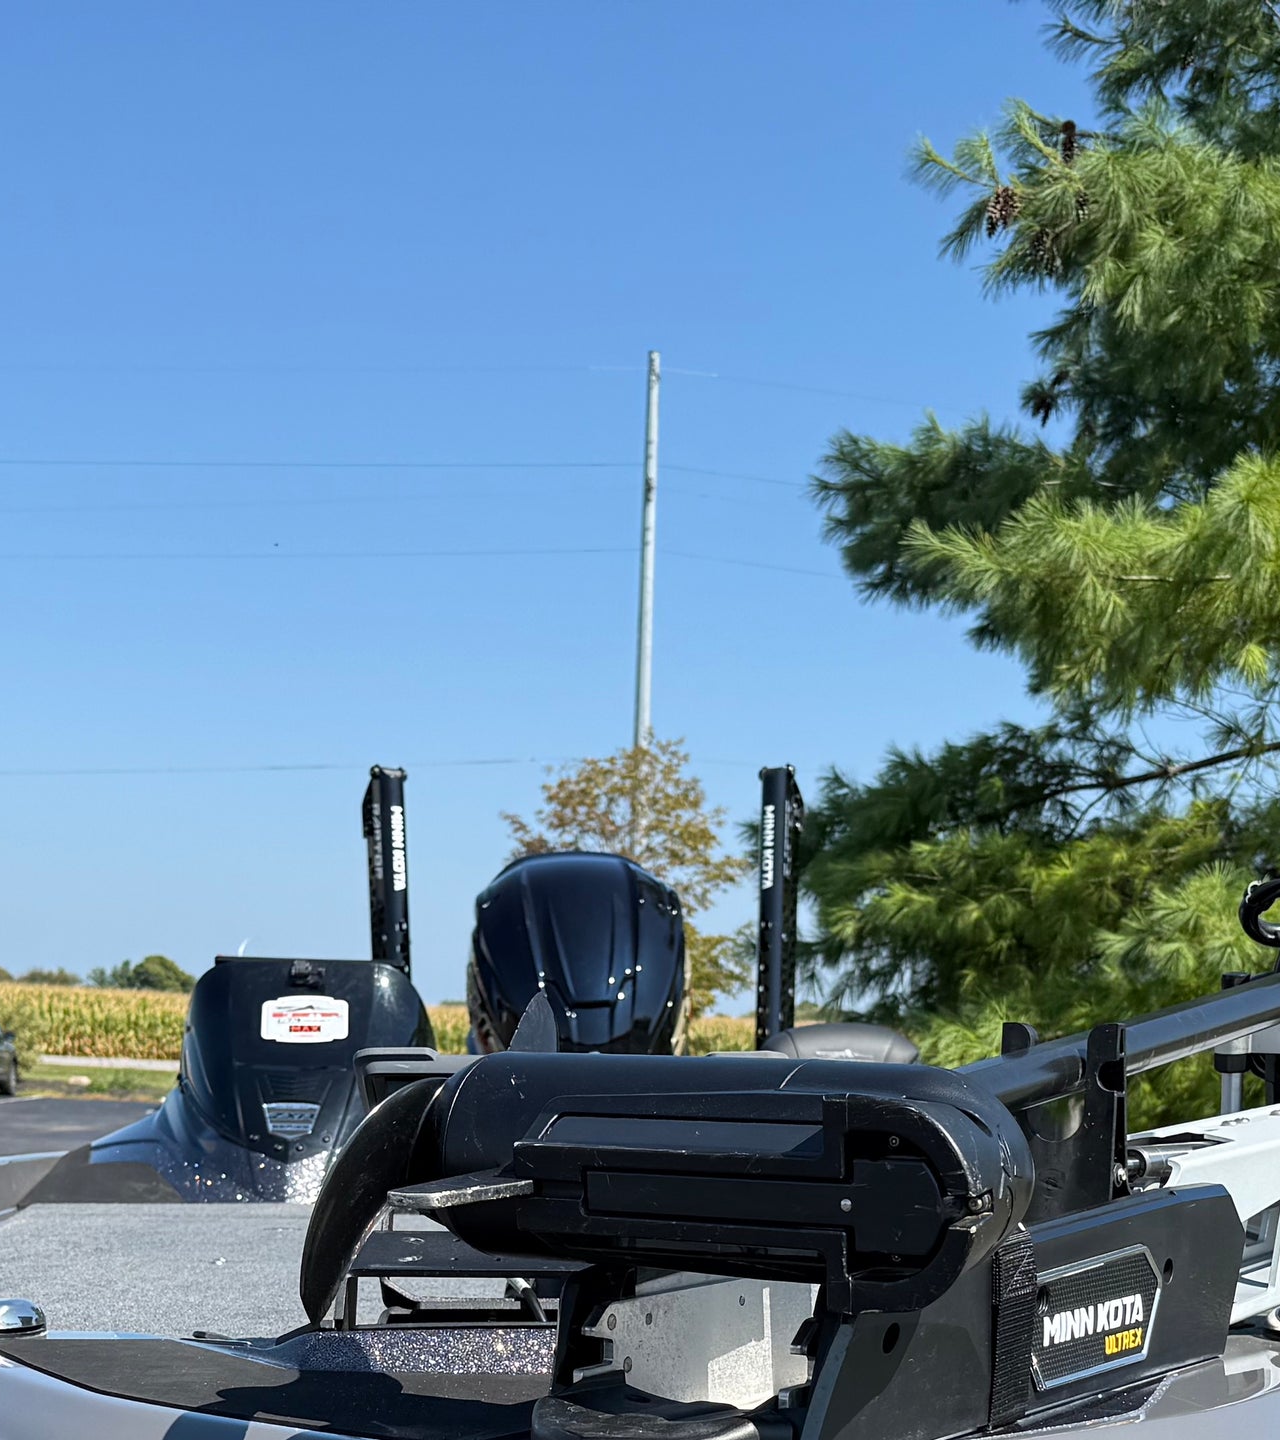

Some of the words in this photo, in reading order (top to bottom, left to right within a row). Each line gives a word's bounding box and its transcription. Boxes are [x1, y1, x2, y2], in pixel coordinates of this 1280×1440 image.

[390, 805, 404, 848] MINN
[763, 804, 775, 847] MINN
[392, 849, 406, 892] KOTA
[762, 848, 775, 890] KOTA
[1043, 1305, 1094, 1347] MINN
[1096, 1294, 1144, 1333] KOTA
[1104, 1327, 1142, 1355] ULTREX
